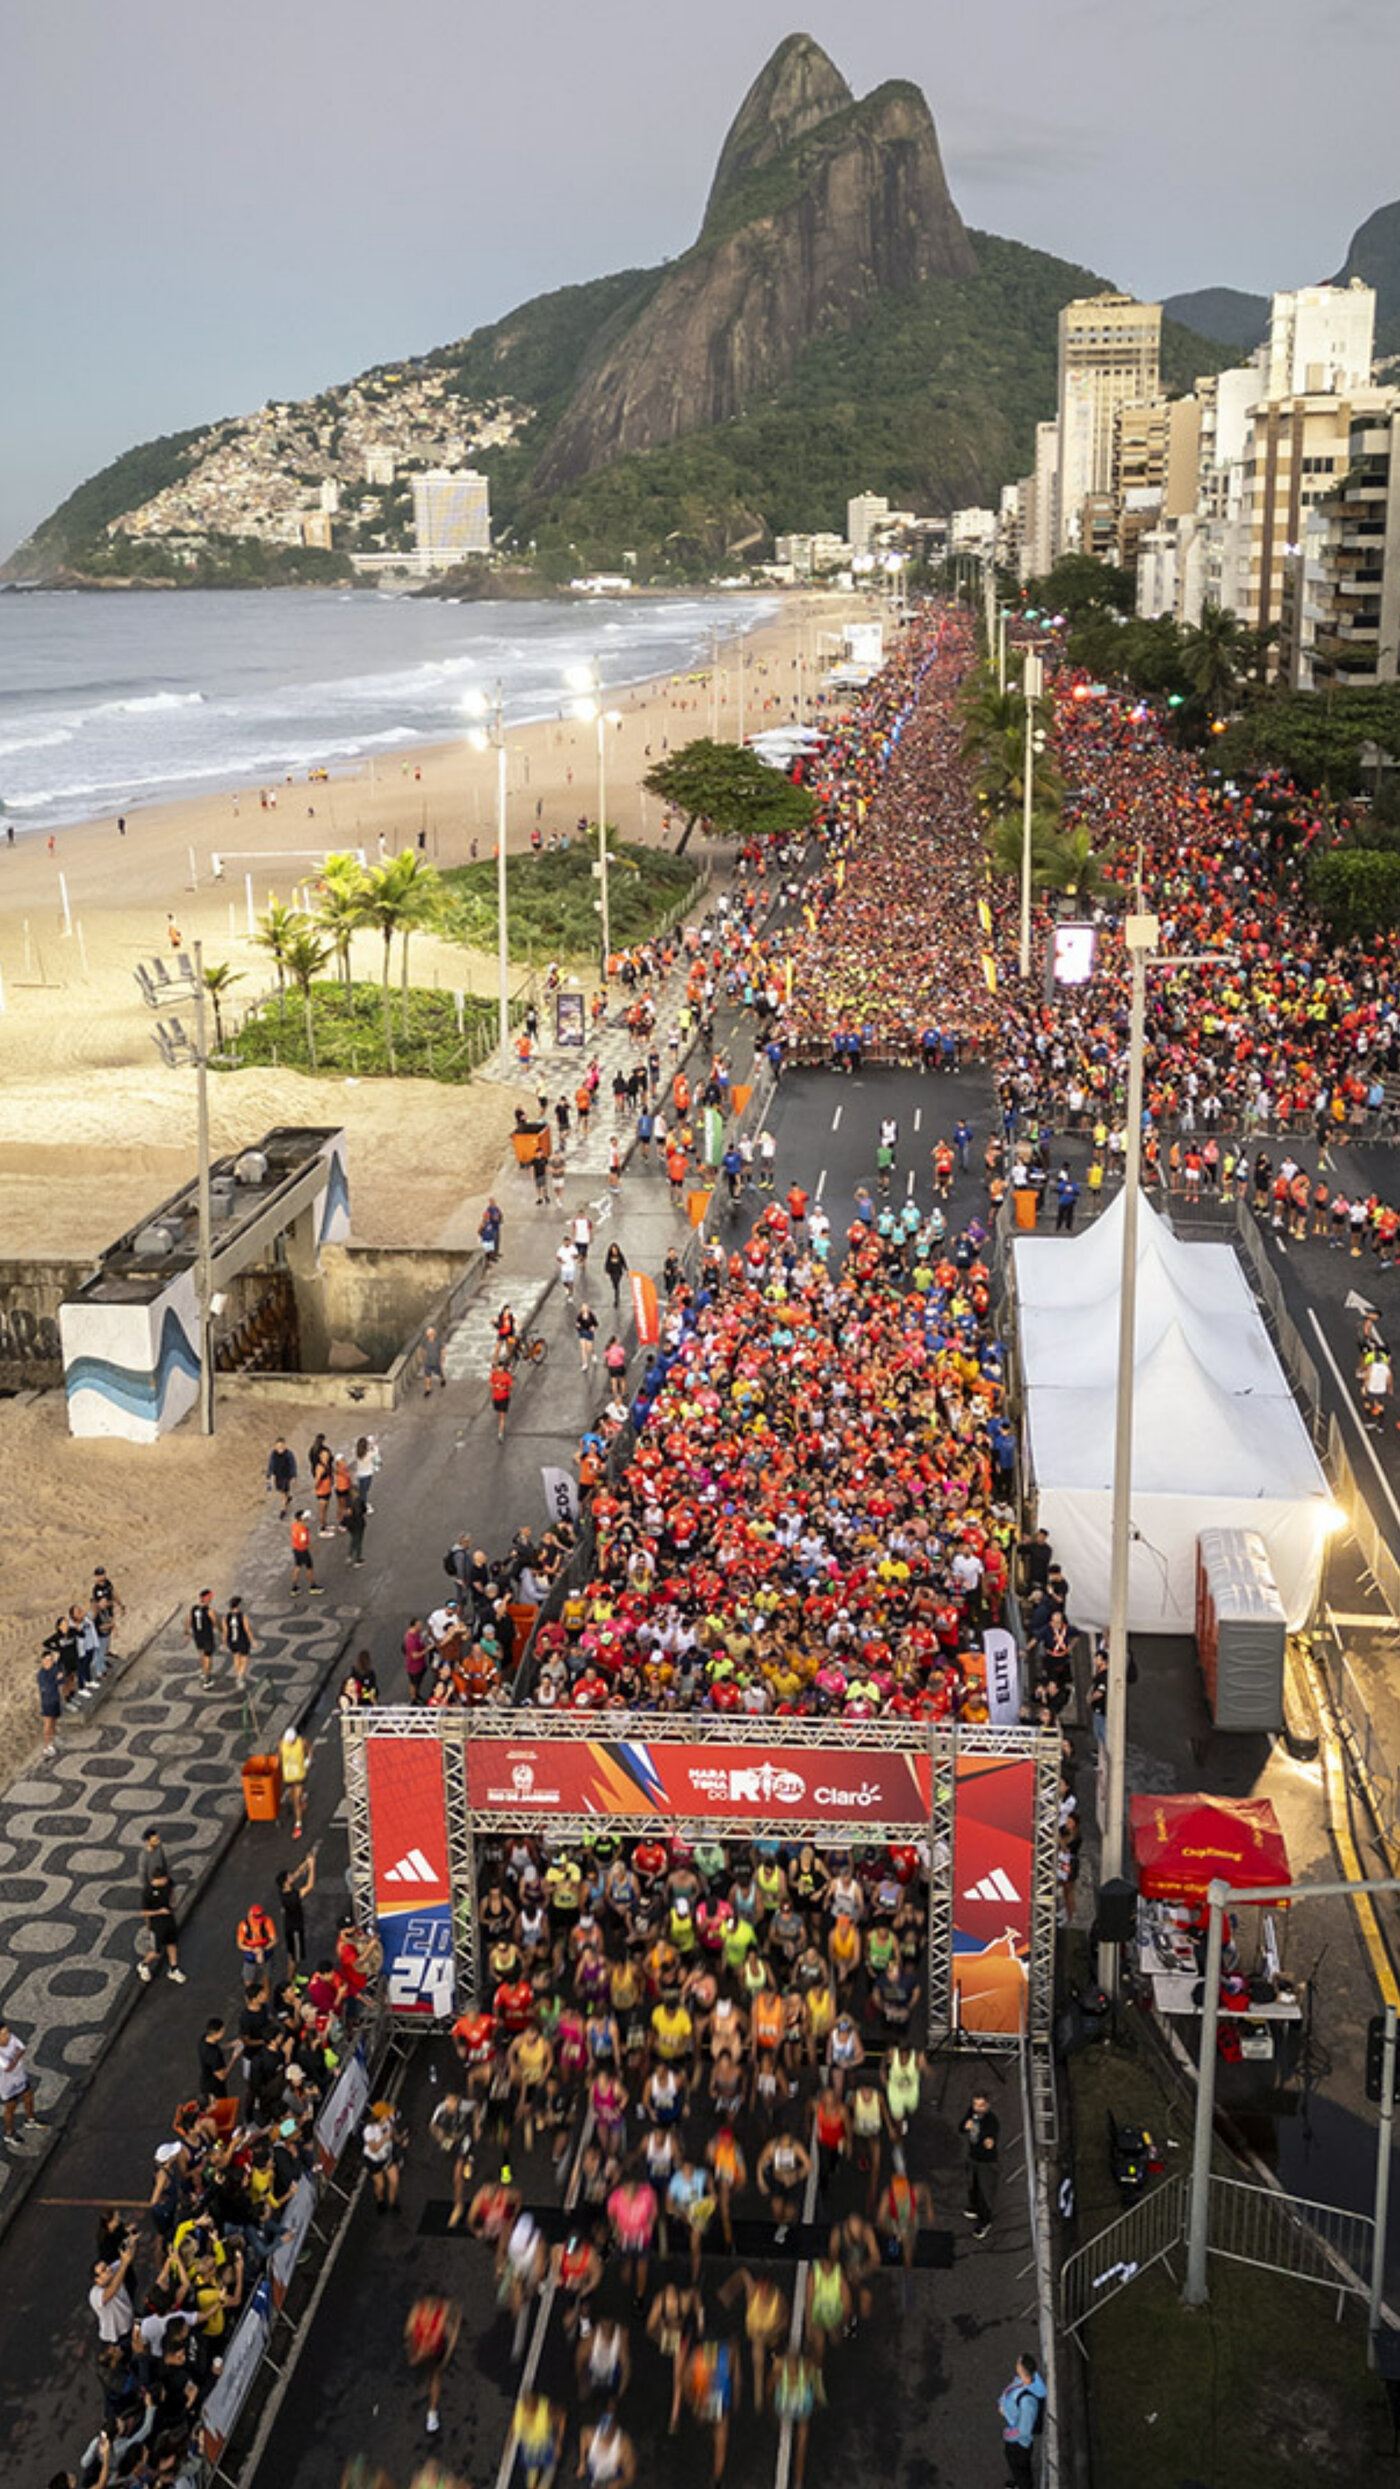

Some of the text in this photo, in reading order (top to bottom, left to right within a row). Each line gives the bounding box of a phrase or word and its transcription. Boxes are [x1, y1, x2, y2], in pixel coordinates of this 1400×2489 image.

[993, 1648, 1010, 1703] ELITE
[688, 1768, 727, 1779] MARA
[729, 1761, 806, 1802] RIO
[813, 1784, 874, 1806] Claro
[401, 1918, 455, 1958] 20
[388, 1956, 455, 2018] 24
